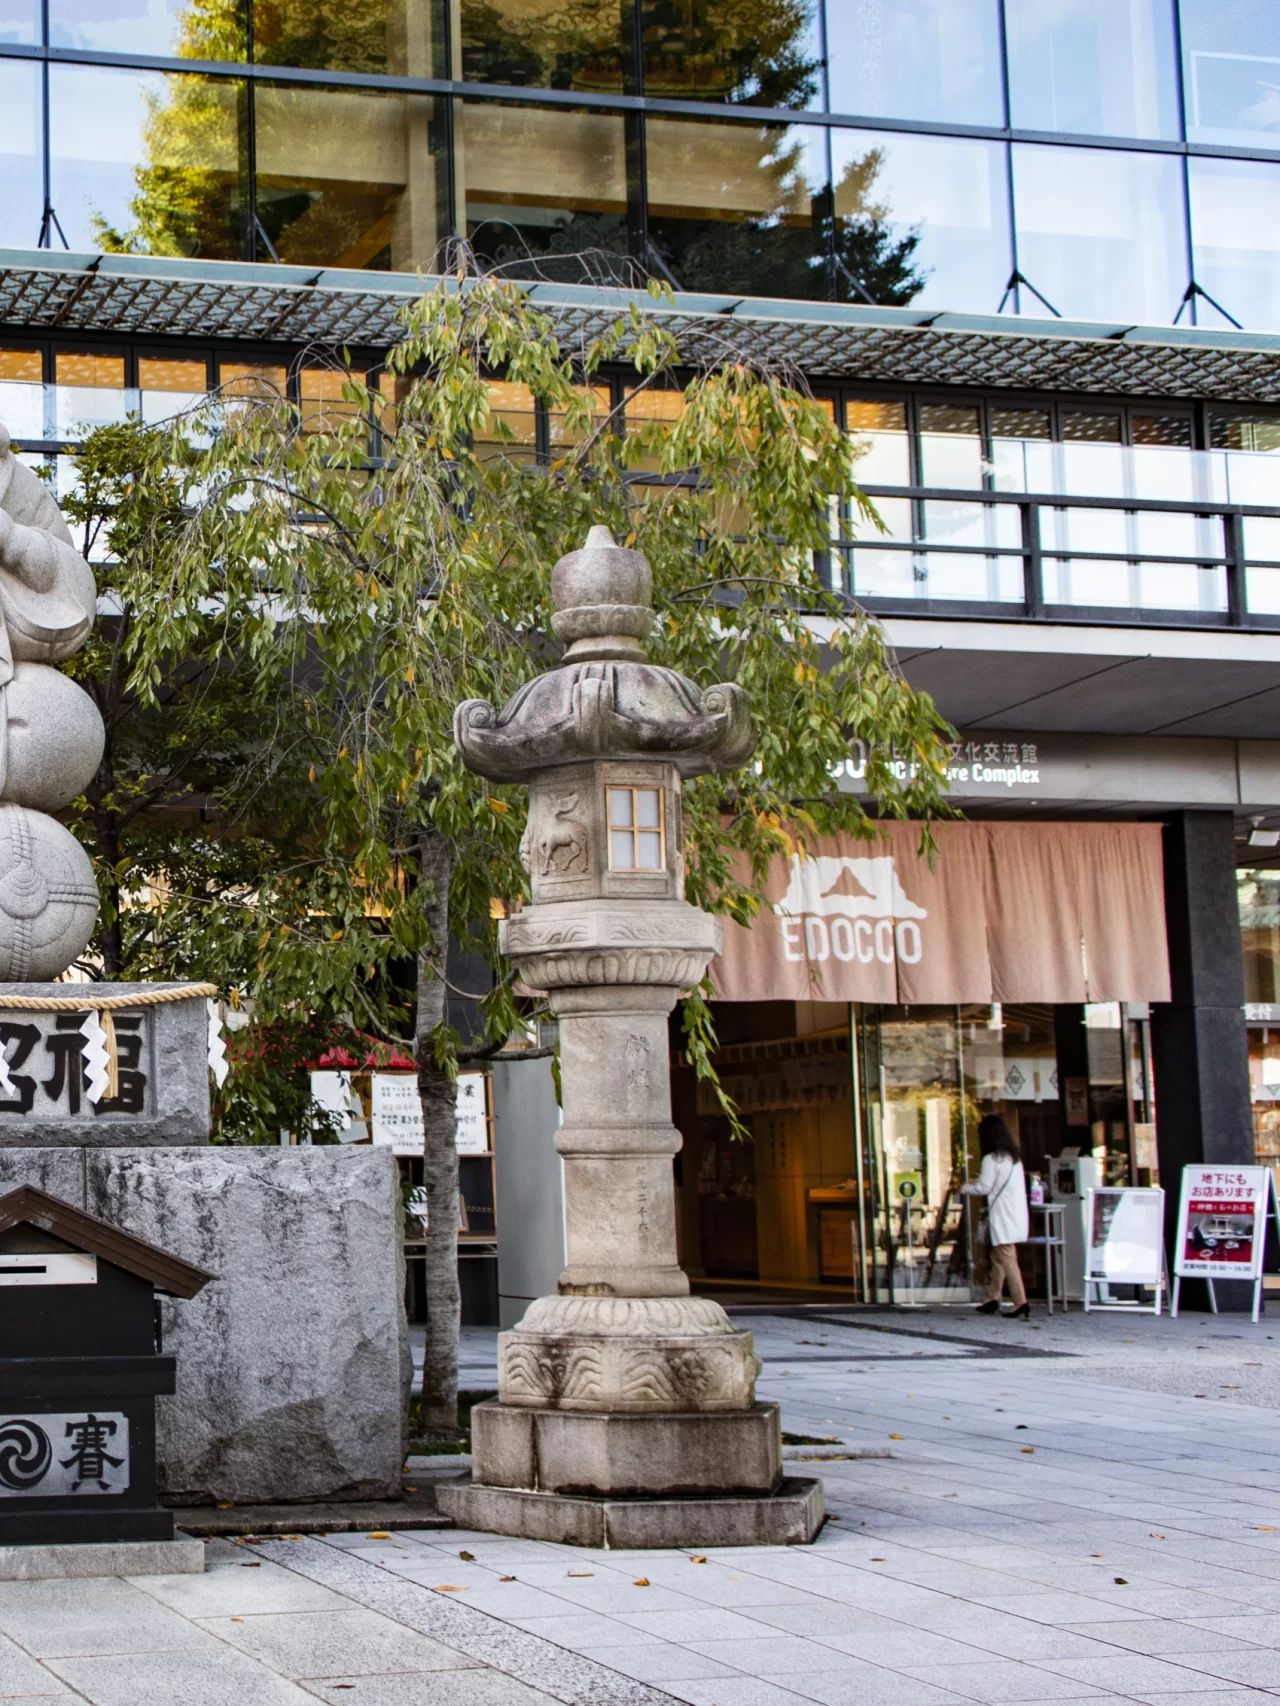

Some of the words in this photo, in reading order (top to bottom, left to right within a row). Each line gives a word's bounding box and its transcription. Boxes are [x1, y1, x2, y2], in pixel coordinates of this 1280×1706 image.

[972, 763, 1040, 787] Complex
[781, 916, 922, 964] EDOCCO
[1201, 1173, 1247, 1185] 地下にも
[1191, 1187, 1256, 1198] お店あります
